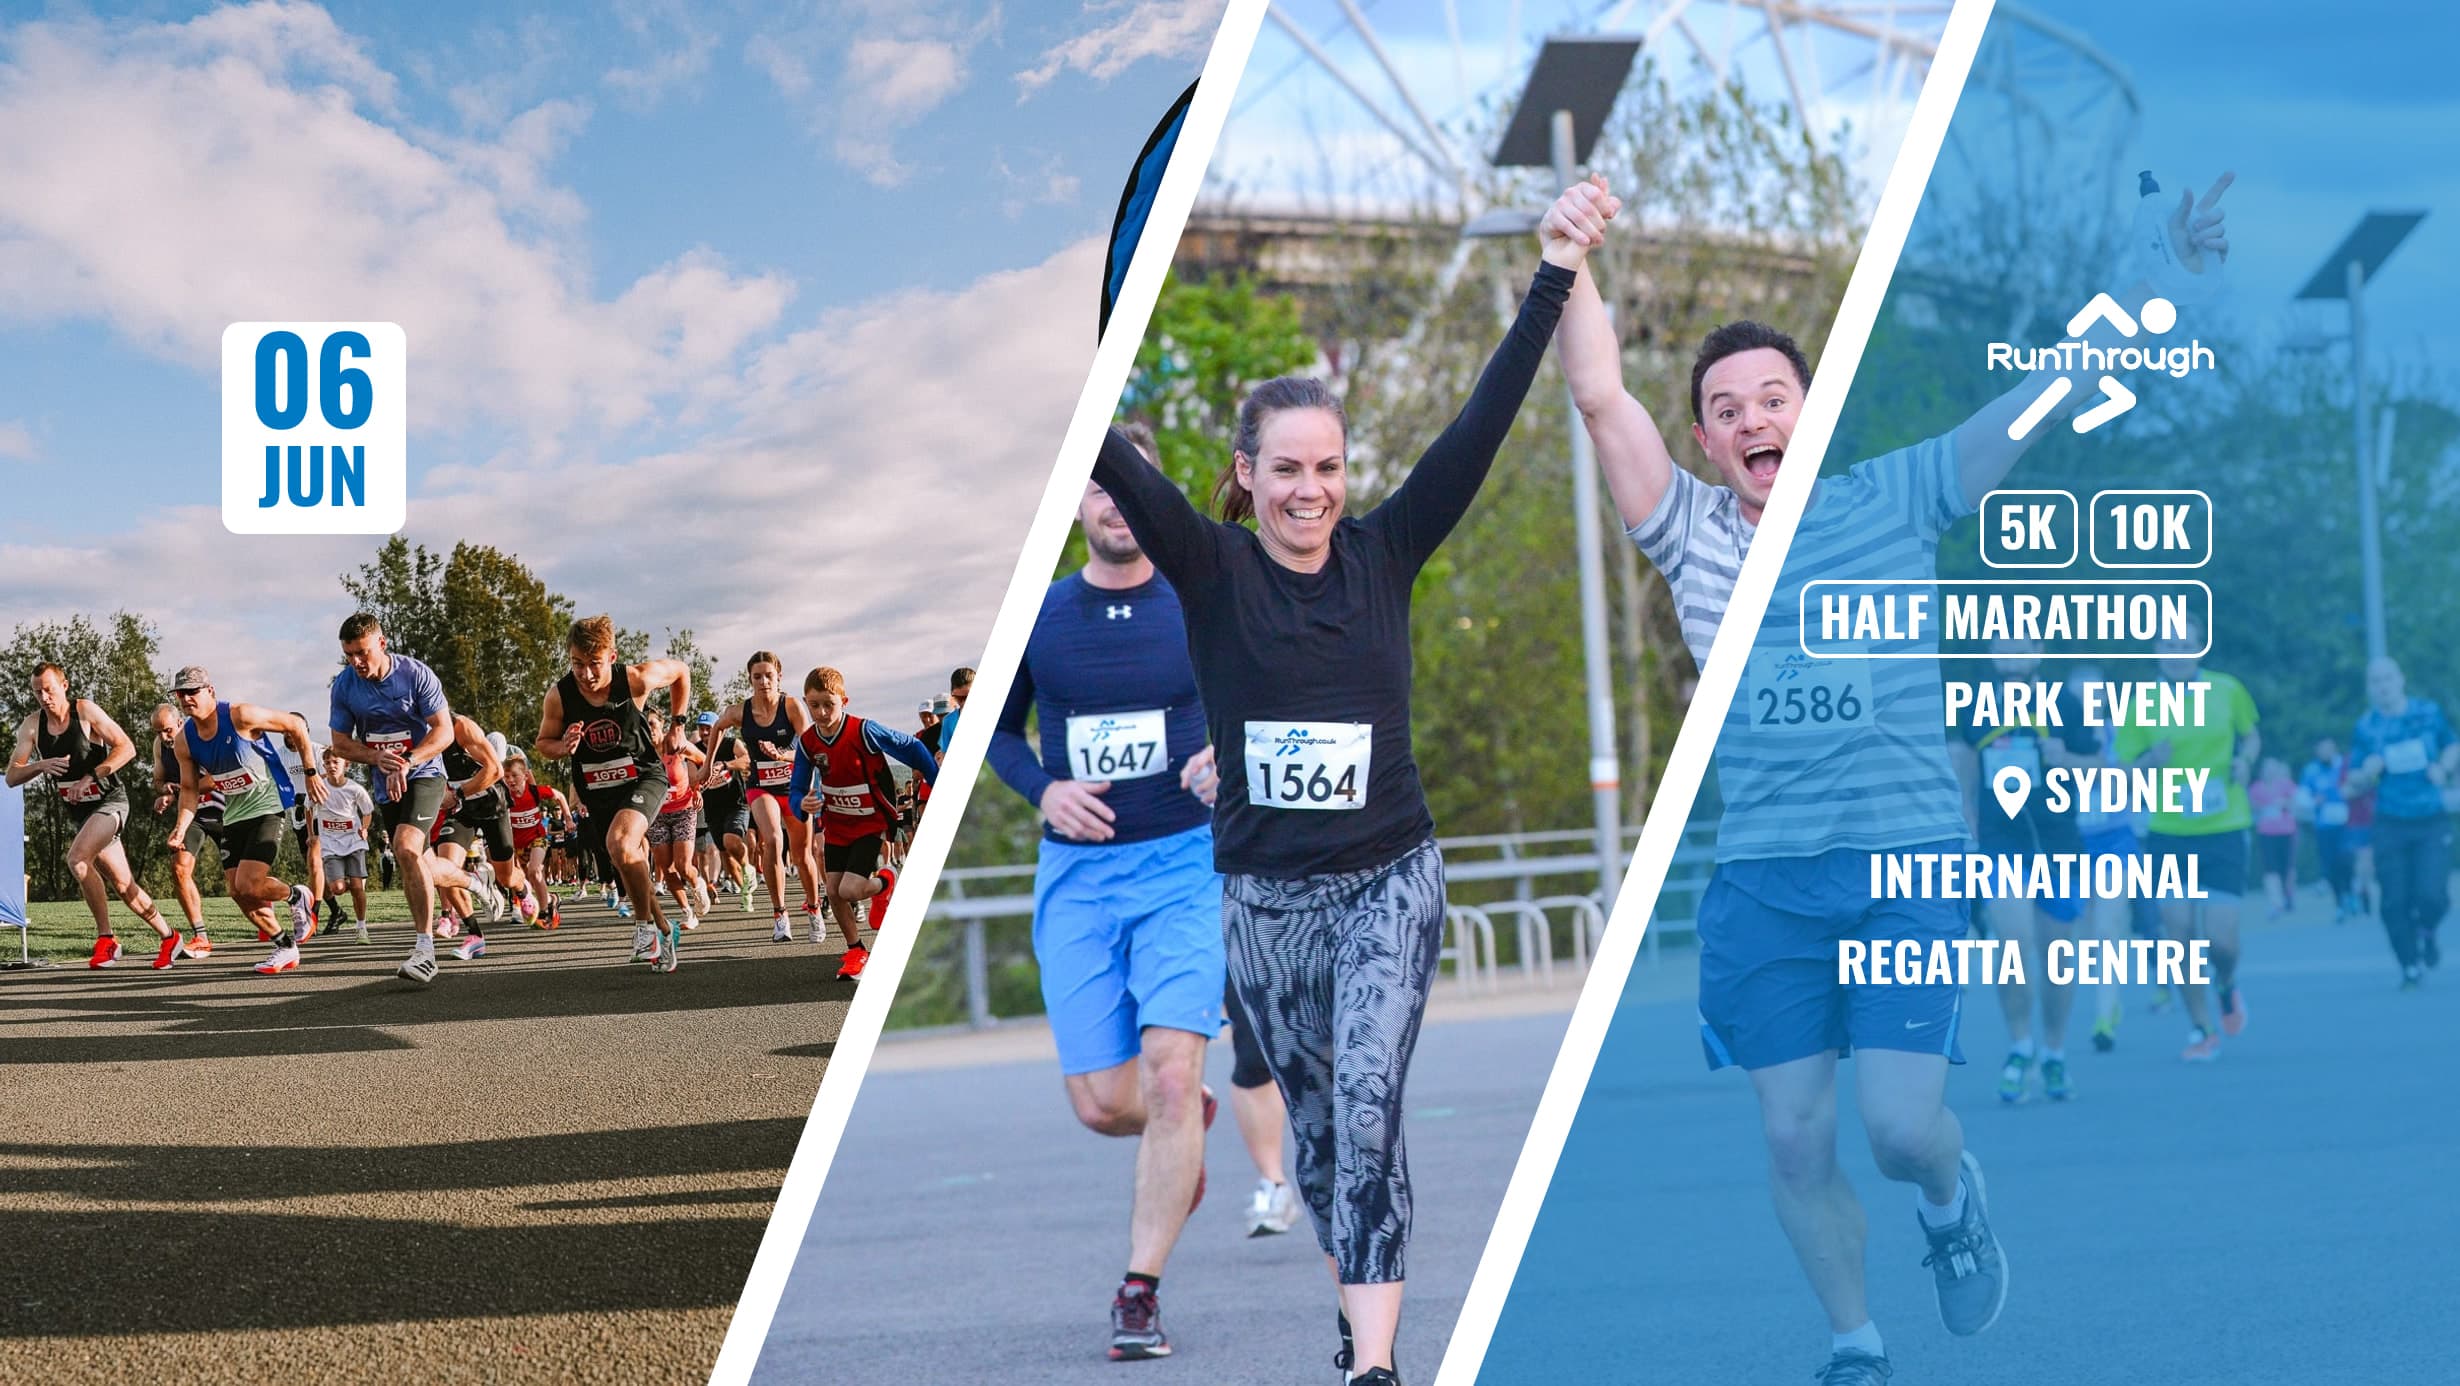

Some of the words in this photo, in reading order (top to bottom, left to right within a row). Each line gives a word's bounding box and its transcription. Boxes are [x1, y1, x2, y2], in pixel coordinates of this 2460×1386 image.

[1757, 683, 1861, 725] 2586
[1080, 741, 1157, 776] 1647
[592, 768, 627, 781] 1079
[764, 767, 792, 779] 1126
[221, 776, 246, 790] 1029
[1259, 763, 1357, 802] 1564
[832, 796, 861, 808] 1119
